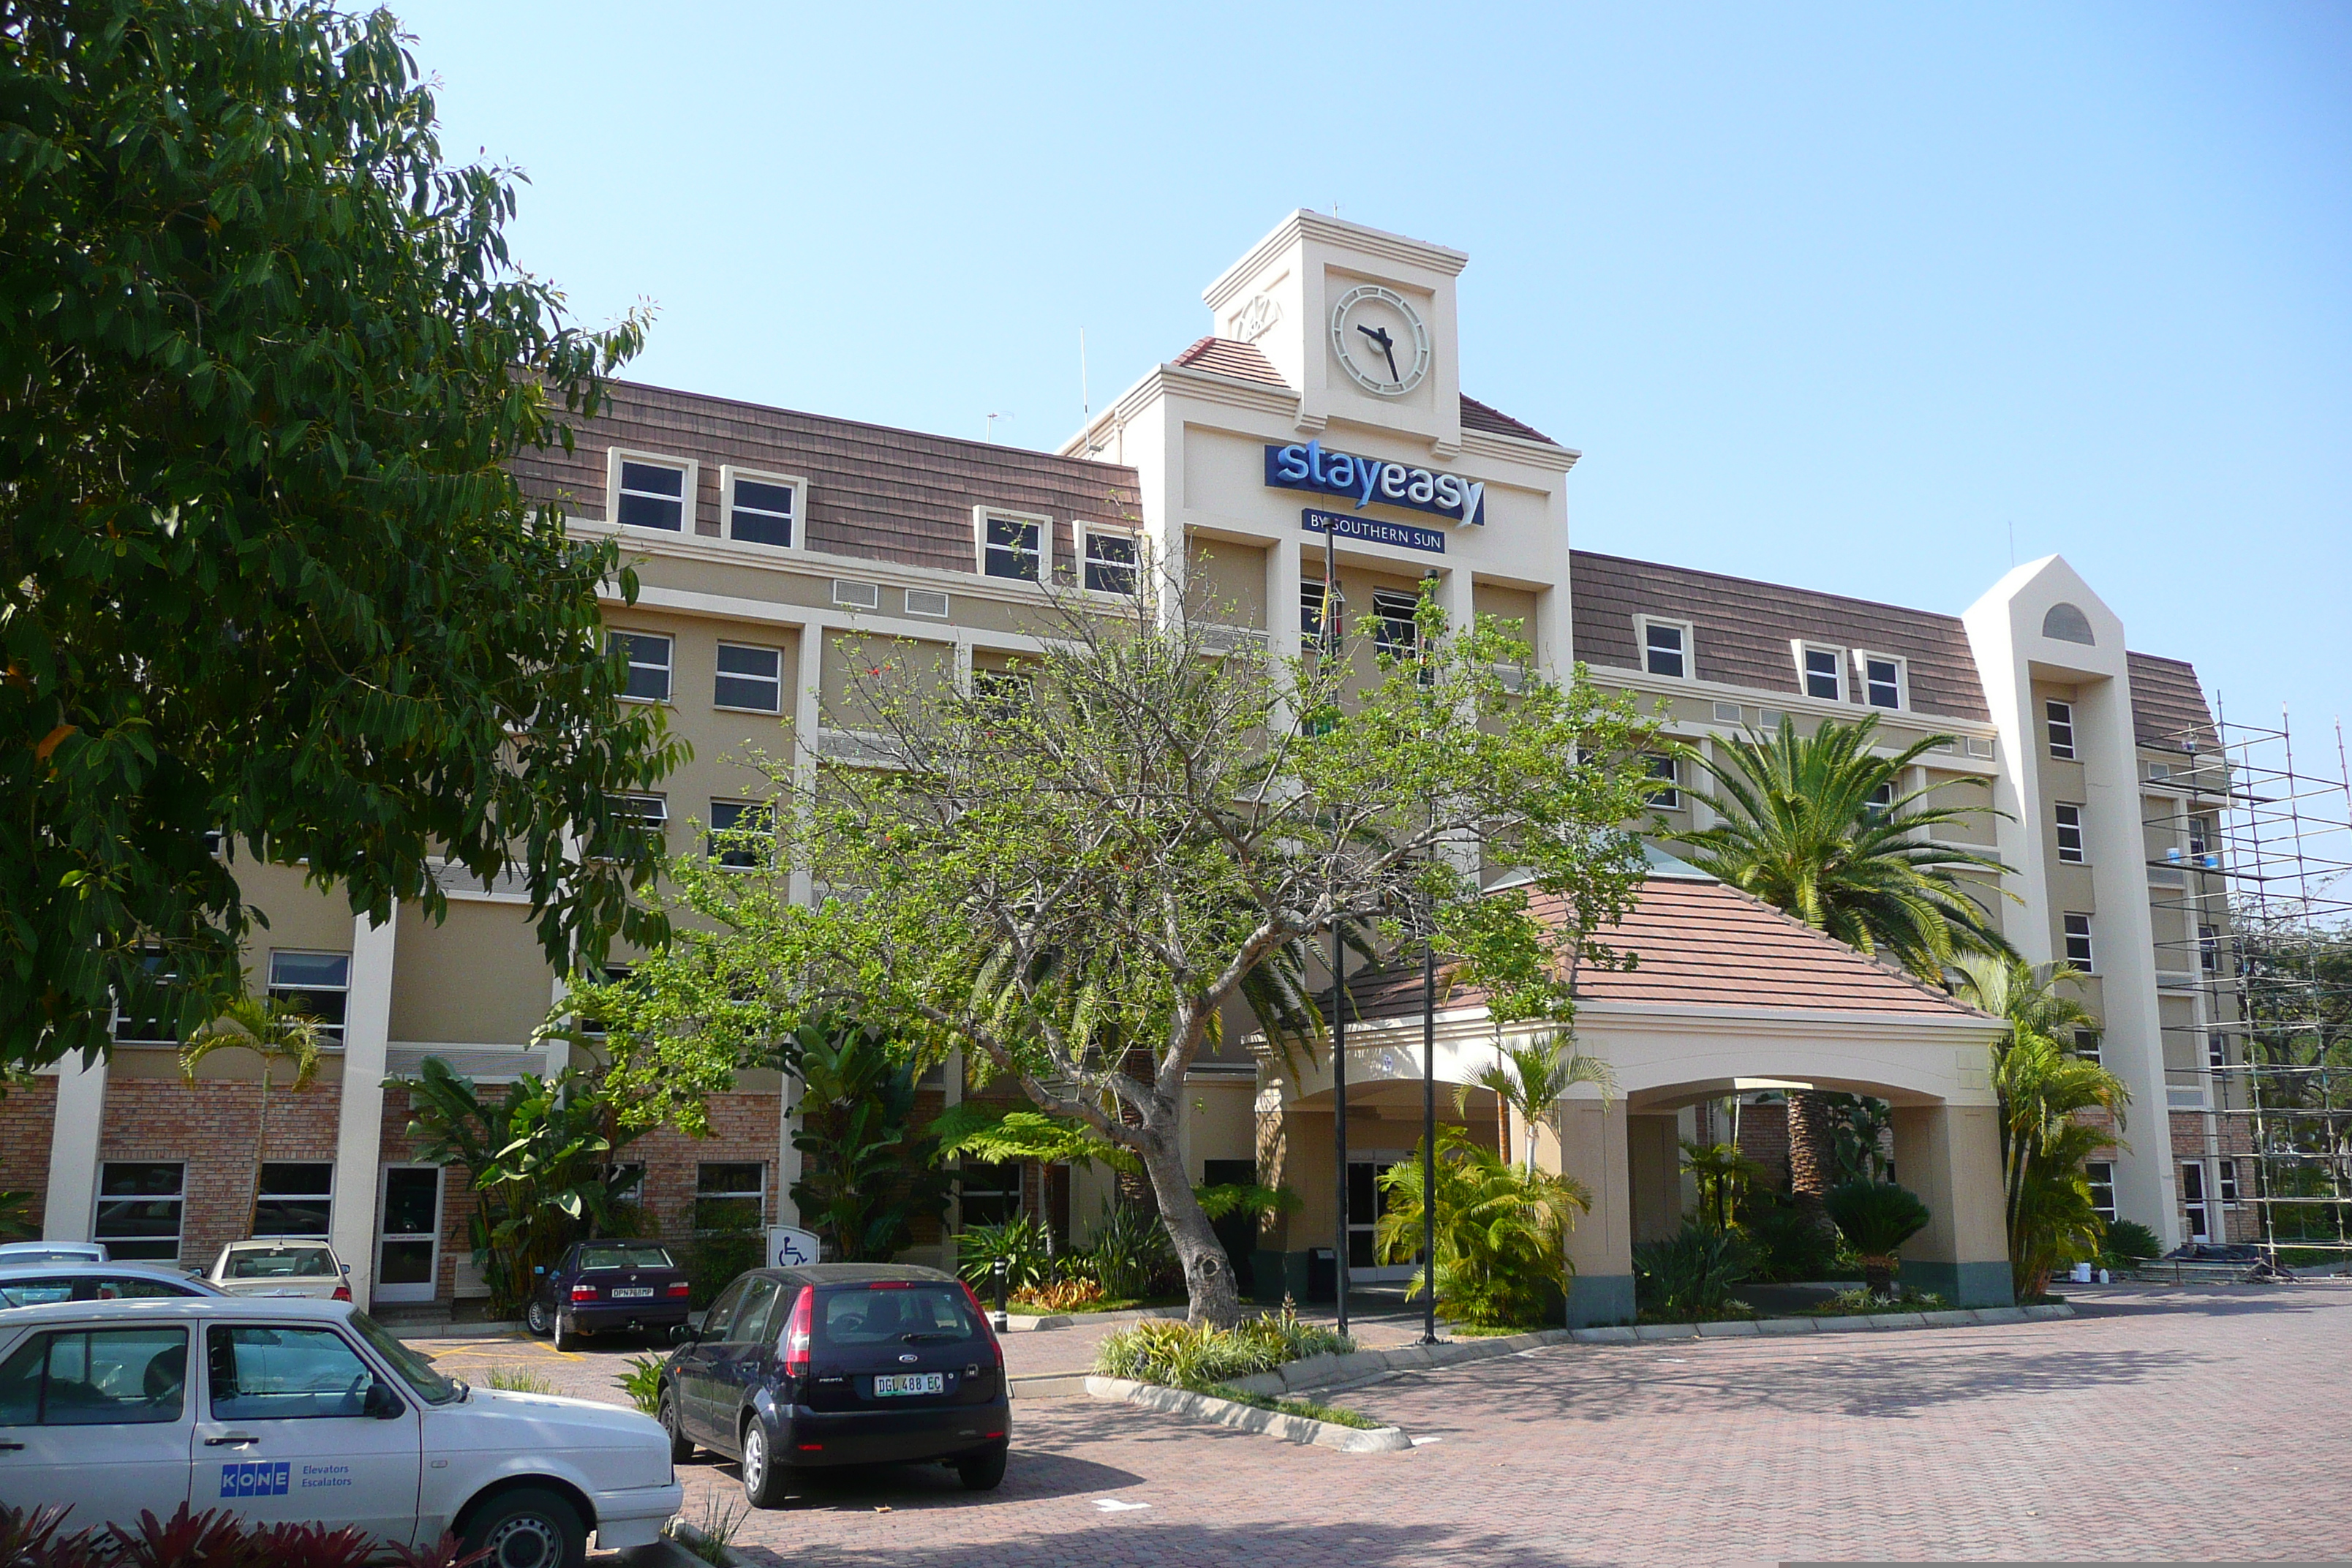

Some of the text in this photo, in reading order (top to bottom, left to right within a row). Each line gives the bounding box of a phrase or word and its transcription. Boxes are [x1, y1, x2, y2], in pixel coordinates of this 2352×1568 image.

[1278, 439, 1485, 528] stayeasy
[1414, 532, 1441, 549] SUN
[902, 1377, 921, 1391] 488
[927, 1376, 941, 1390] EC
[303, 1465, 349, 1474] Elevators
[222, 1472, 287, 1488] KONE
[302, 1477, 352, 1488] Escalators
